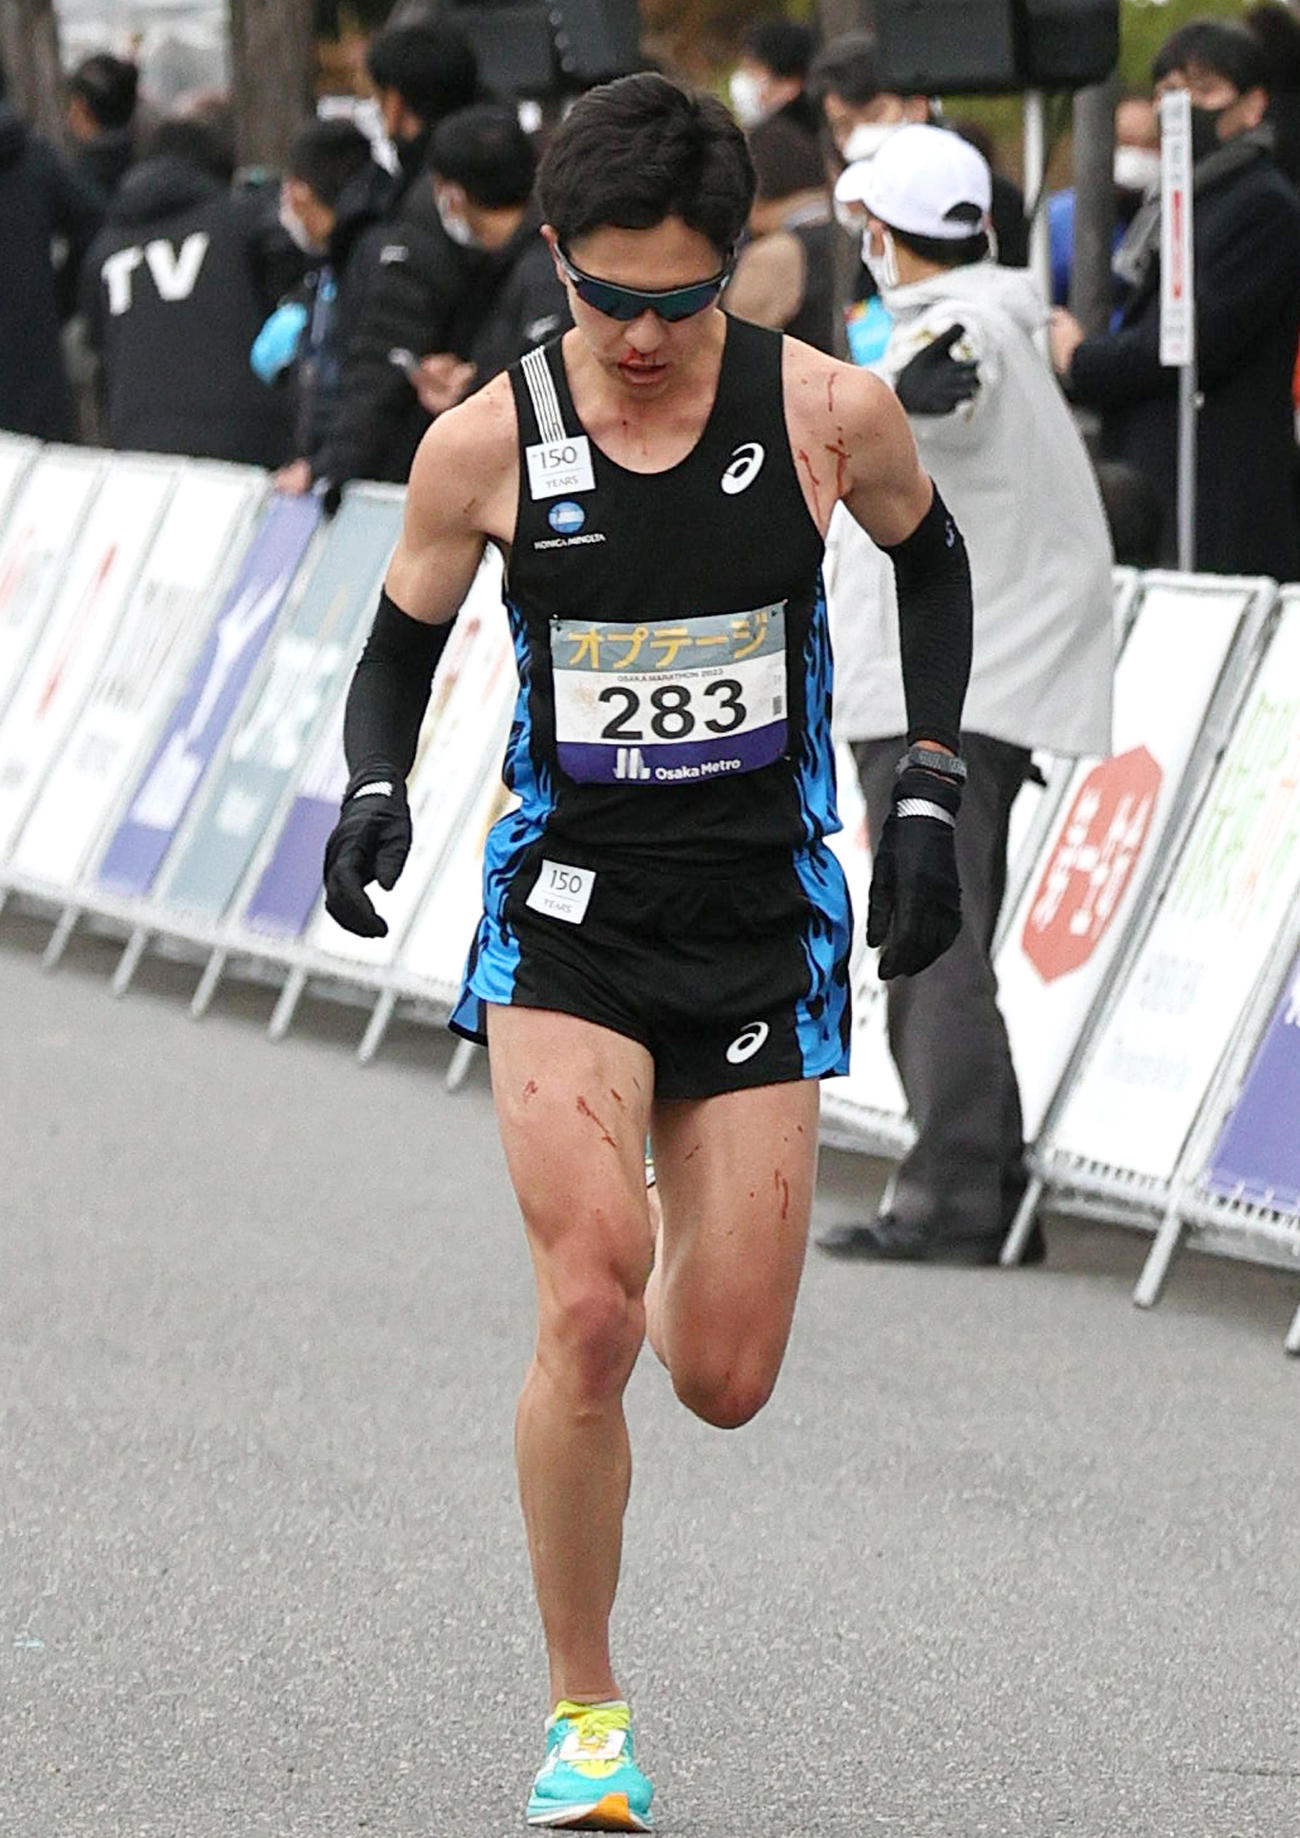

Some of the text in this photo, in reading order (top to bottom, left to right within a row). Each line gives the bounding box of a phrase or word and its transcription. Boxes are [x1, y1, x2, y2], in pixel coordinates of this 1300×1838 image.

[101, 231, 210, 316] TV
[540, 446, 577, 469] 150
[545, 475, 579, 489] YEARS
[567, 611, 768, 669] オプテージ
[617, 674, 648, 682] OSAKA
[649, 671, 699, 682] MARATHON
[598, 679, 747, 740] 283
[655, 758, 741, 780] Osaka Metro
[550, 869, 582, 894] 150
